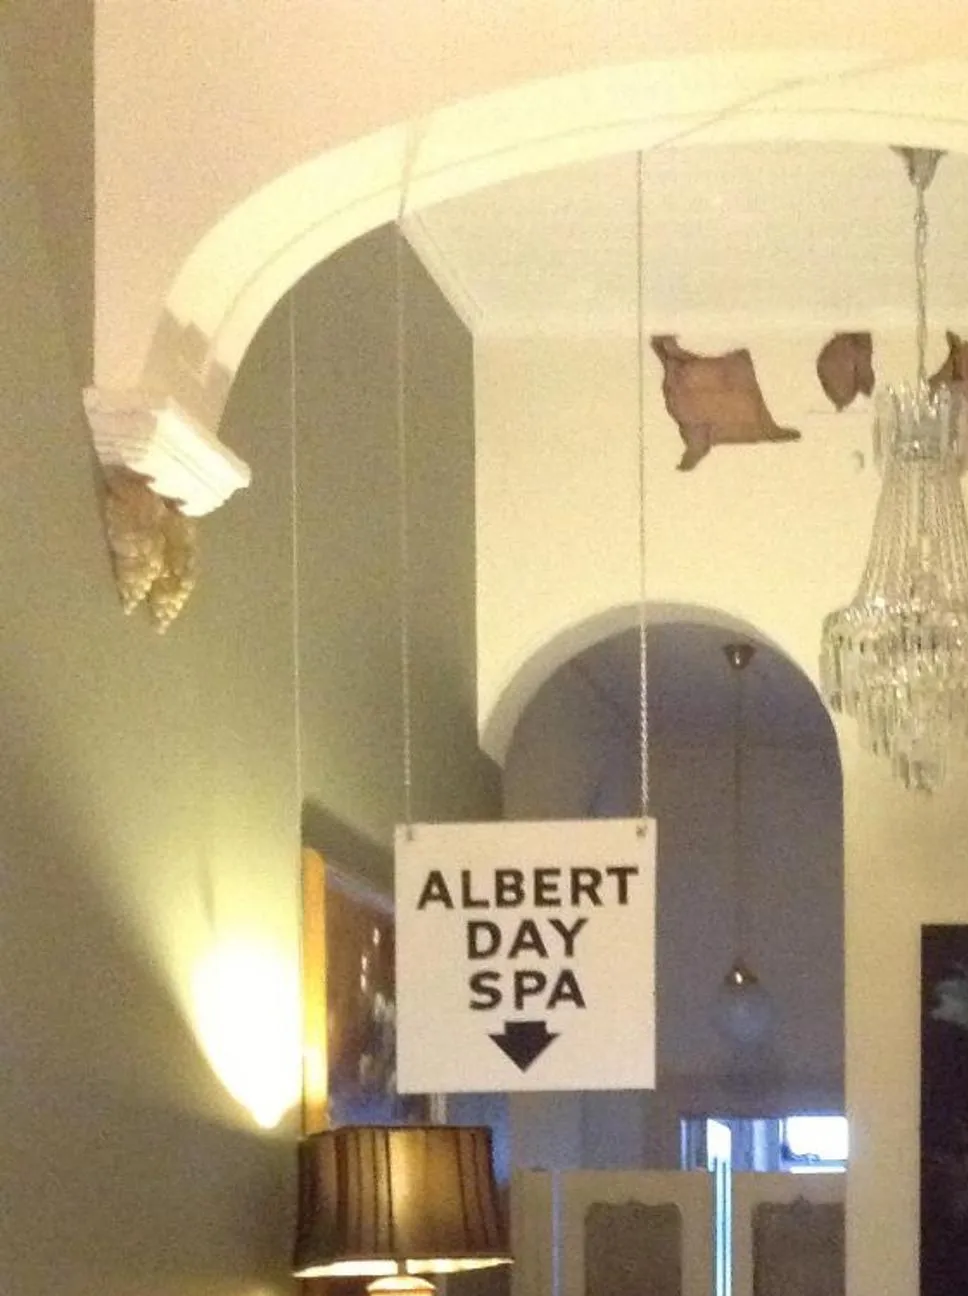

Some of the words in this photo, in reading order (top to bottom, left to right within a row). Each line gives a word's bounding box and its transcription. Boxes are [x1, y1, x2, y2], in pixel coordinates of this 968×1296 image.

[416, 866, 639, 911] ALBERT
[466, 917, 589, 960] DAY
[468, 969, 586, 1011] SPA
